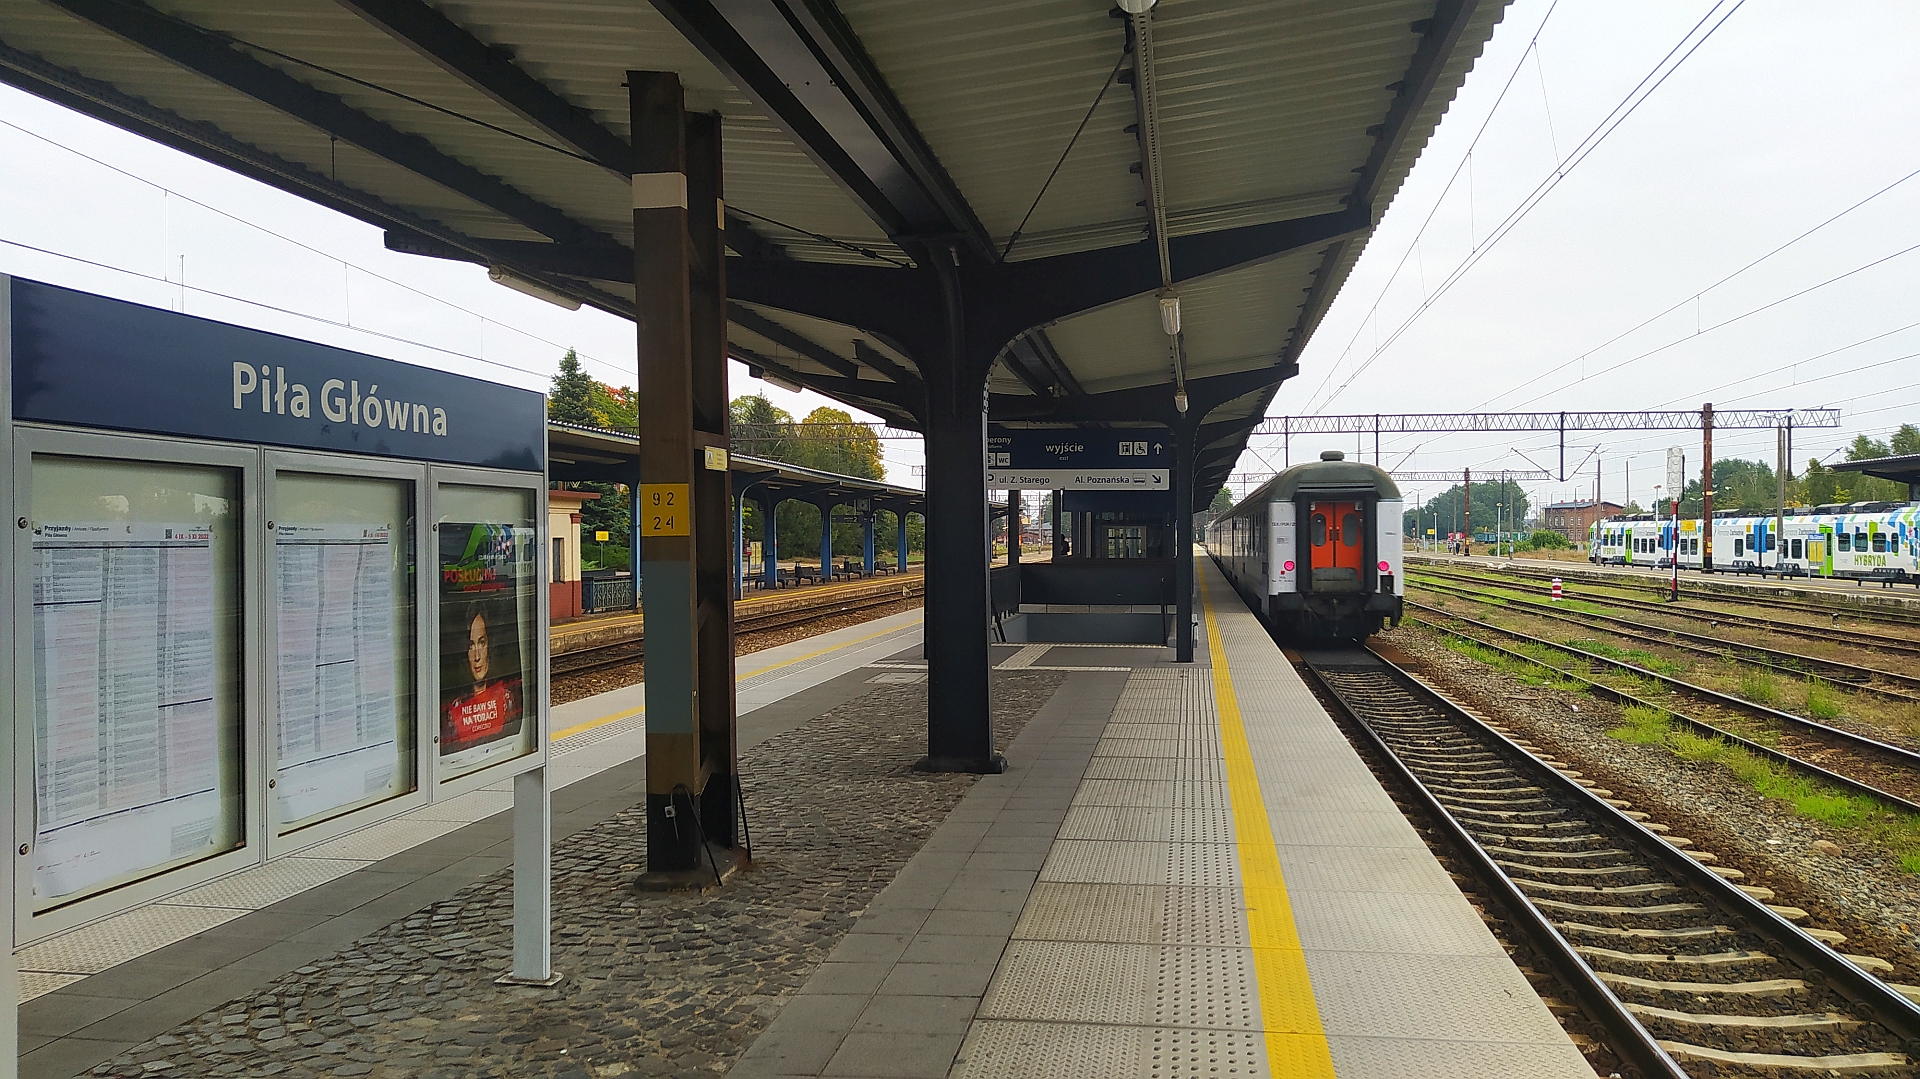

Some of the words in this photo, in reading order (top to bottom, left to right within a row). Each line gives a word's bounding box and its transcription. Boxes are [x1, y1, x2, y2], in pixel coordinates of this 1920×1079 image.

[231, 361, 312, 419] Piła
[320, 379, 448, 437] Główna
[1045, 441, 1085, 455] wyjście
[999, 476, 1008, 484] ul.
[1010, 476, 1018, 484] Z.
[1019, 476, 1050, 486] Starego
[1075, 476, 1086, 484] Al.
[1087, 475, 1130, 484] Poznańska
[44, 525, 71, 533] Przyjazdy
[1854, 554, 1887, 567] HYBRYDA
[461, 704, 473, 715] NIE
[473, 702, 487, 713] BAW
[487, 699, 497, 710] SIĘ
[462, 715, 474, 726] NA
[473, 711, 498, 724] TORACH
